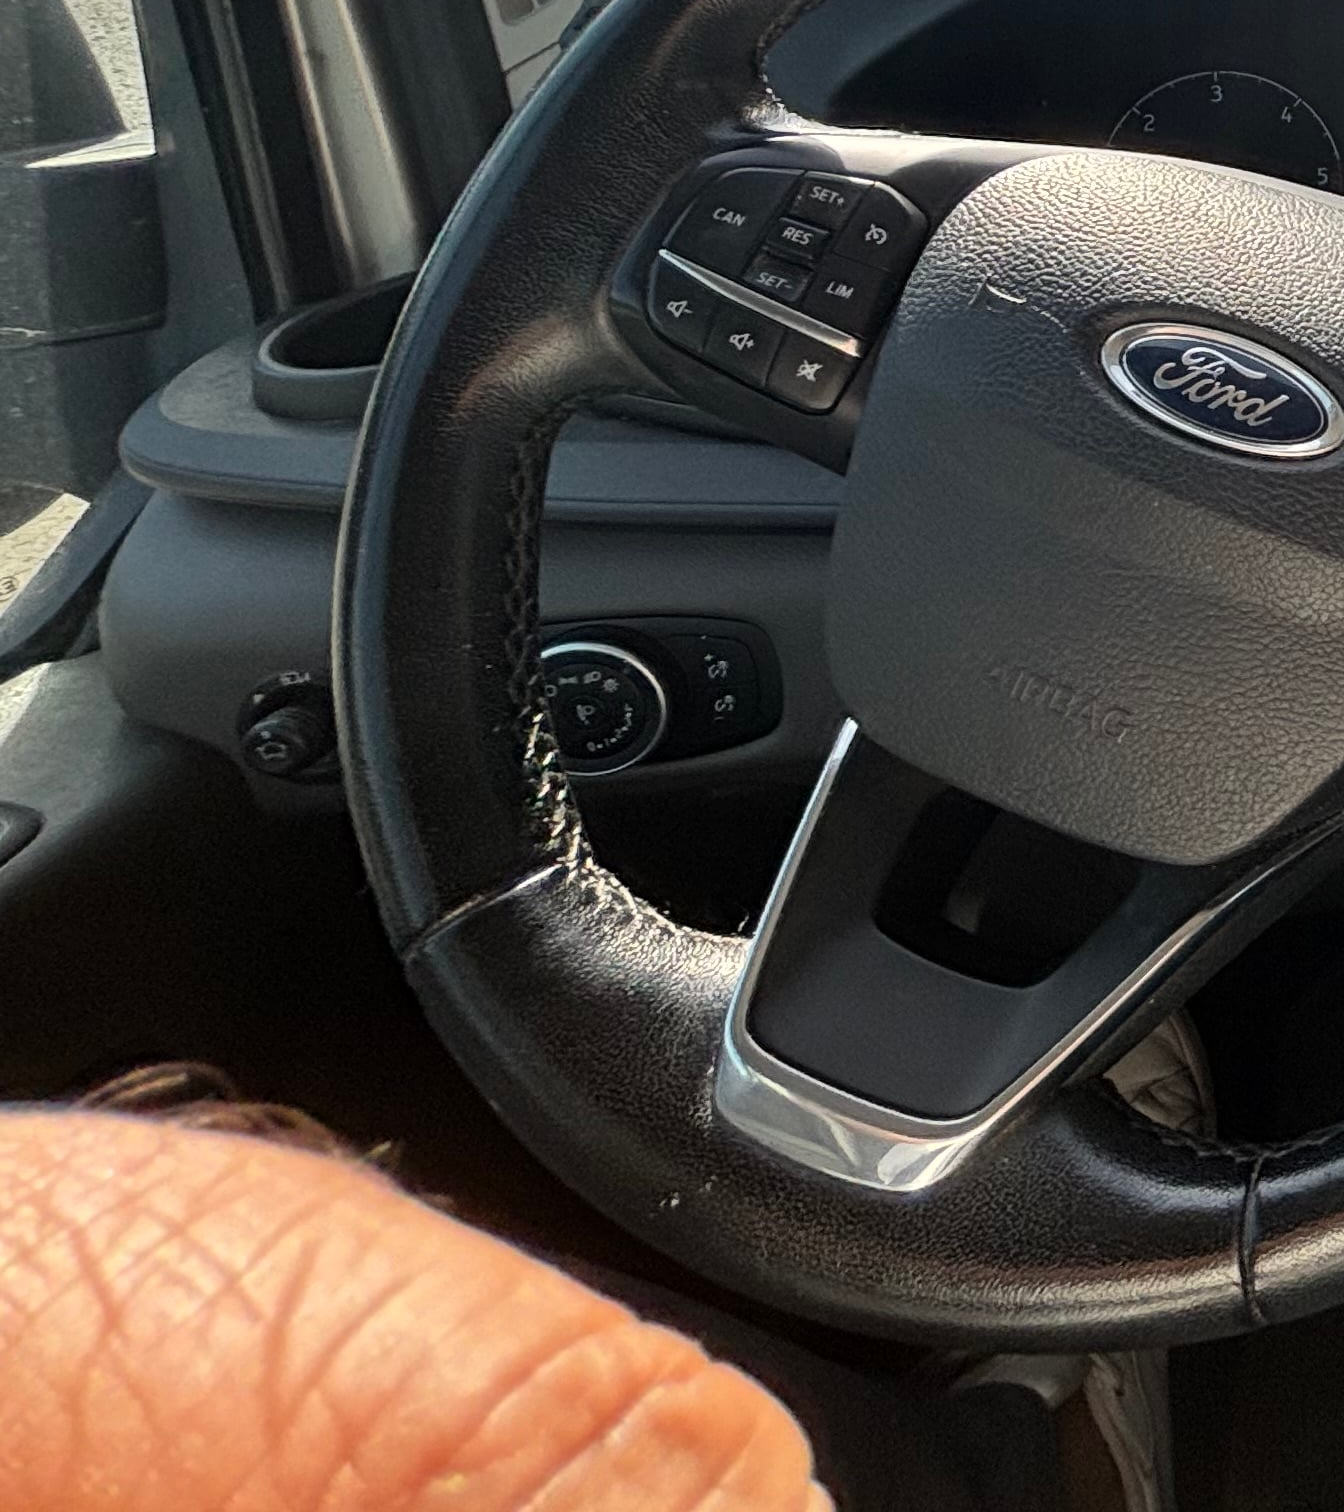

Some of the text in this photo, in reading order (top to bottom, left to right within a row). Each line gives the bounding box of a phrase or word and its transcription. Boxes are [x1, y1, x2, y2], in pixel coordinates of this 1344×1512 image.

[1210, 85, 1223, 103] 3
[1143, 113, 1156, 133] 2
[1280, 106, 1293, 124] 4
[1316, 167, 1329, 186] 5
[809, 185, 846, 208] SET+
[711, 207, 746, 227] CAN
[782, 226, 814, 246] RES
[826, 281, 854, 300] LIM
[1153, 346, 1289, 427] Ford
